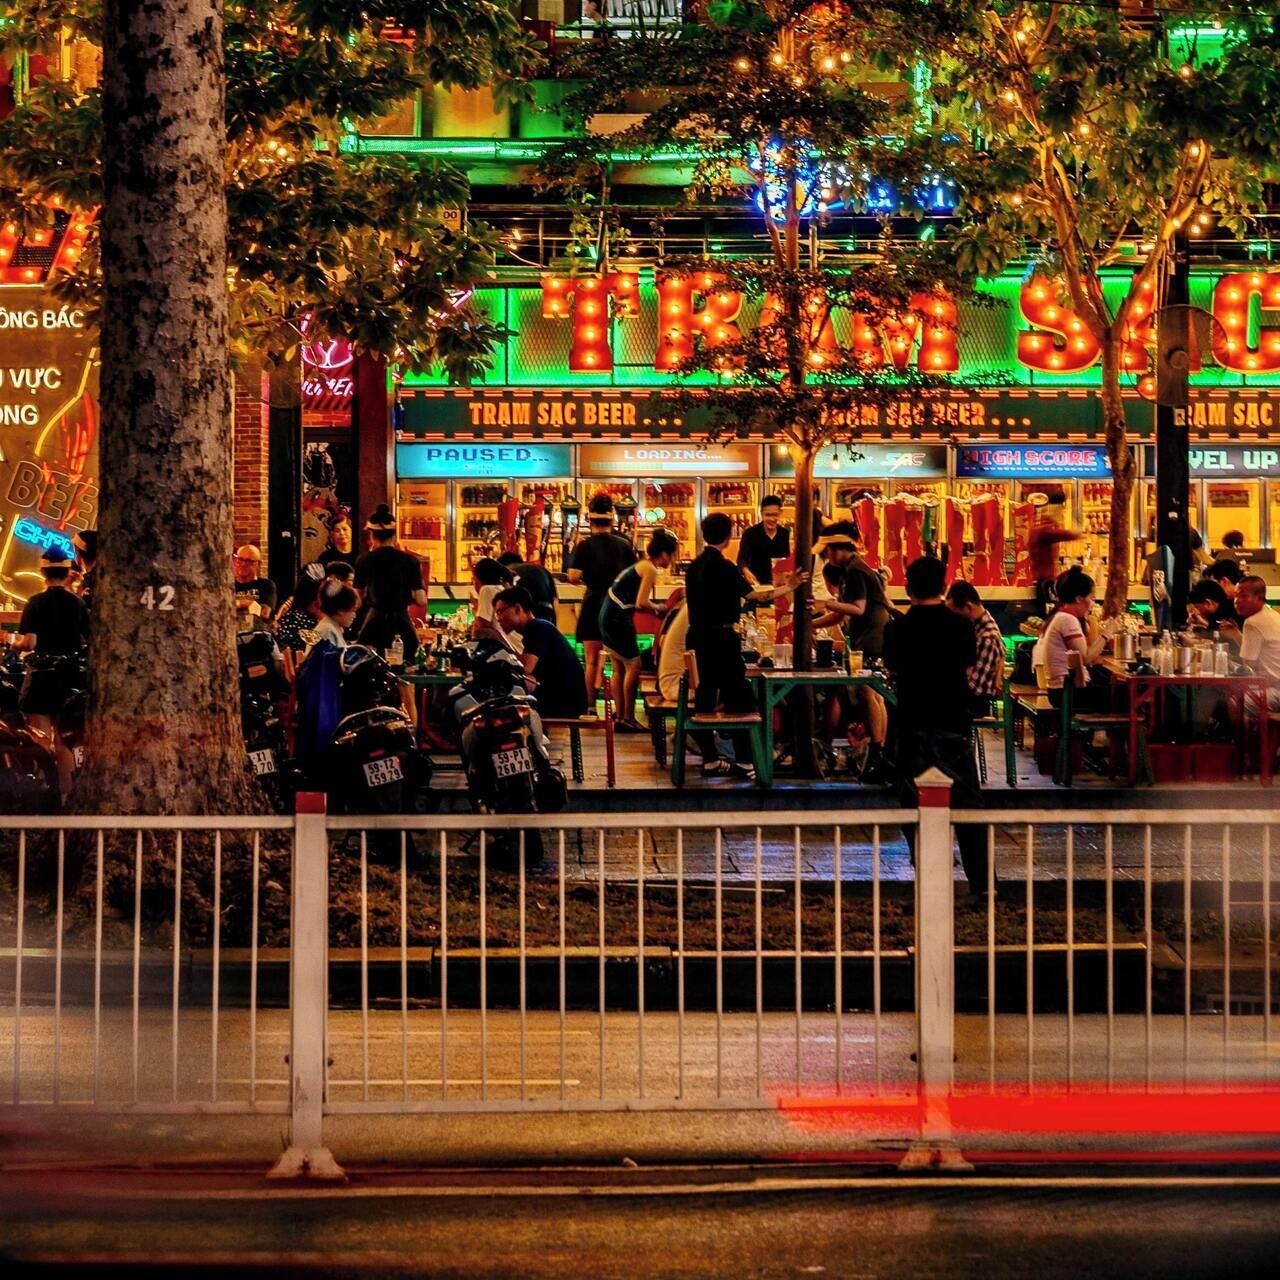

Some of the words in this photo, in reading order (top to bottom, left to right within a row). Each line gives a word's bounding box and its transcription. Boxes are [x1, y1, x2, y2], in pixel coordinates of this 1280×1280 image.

[9, 367, 63, 395] VỰC
[584, 402, 636, 426] BEER
[1024, 450, 1097, 466] SCORE
[139, 584, 176, 611] 42
